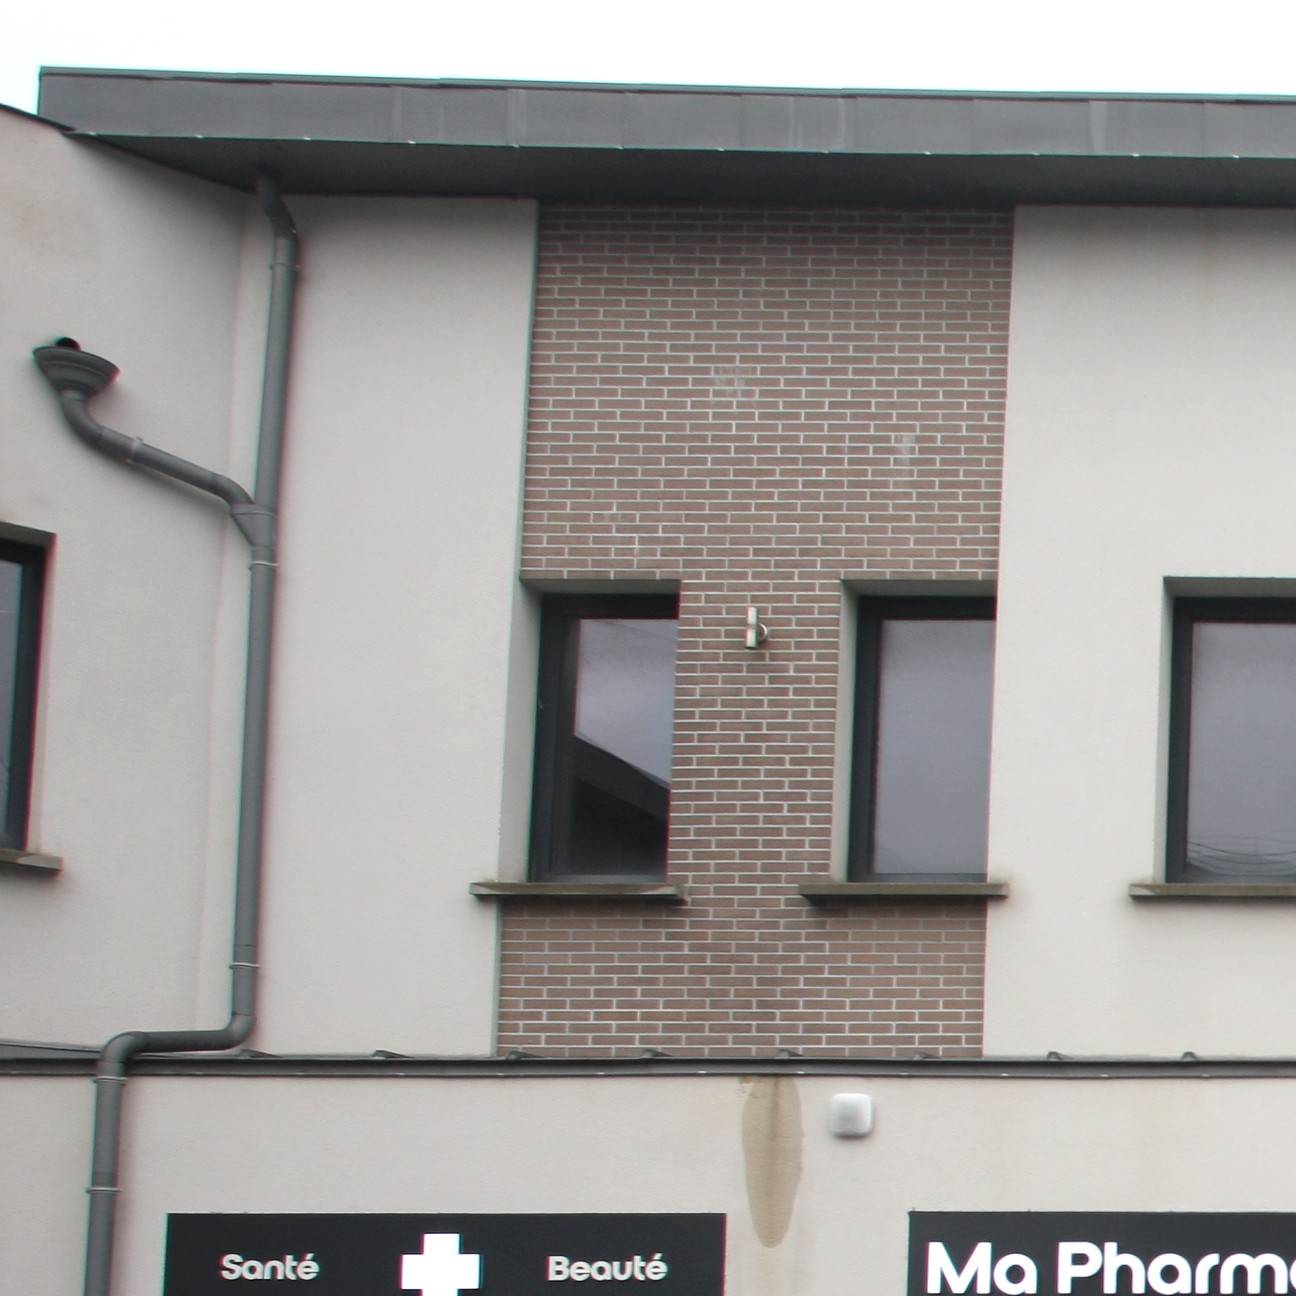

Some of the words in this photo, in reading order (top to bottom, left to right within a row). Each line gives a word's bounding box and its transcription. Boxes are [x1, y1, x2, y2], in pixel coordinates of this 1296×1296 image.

[220, 1252, 320, 1281] Santé
[547, 1253, 668, 1281] Beauté
[926, 1242, 1037, 1295] Ma
